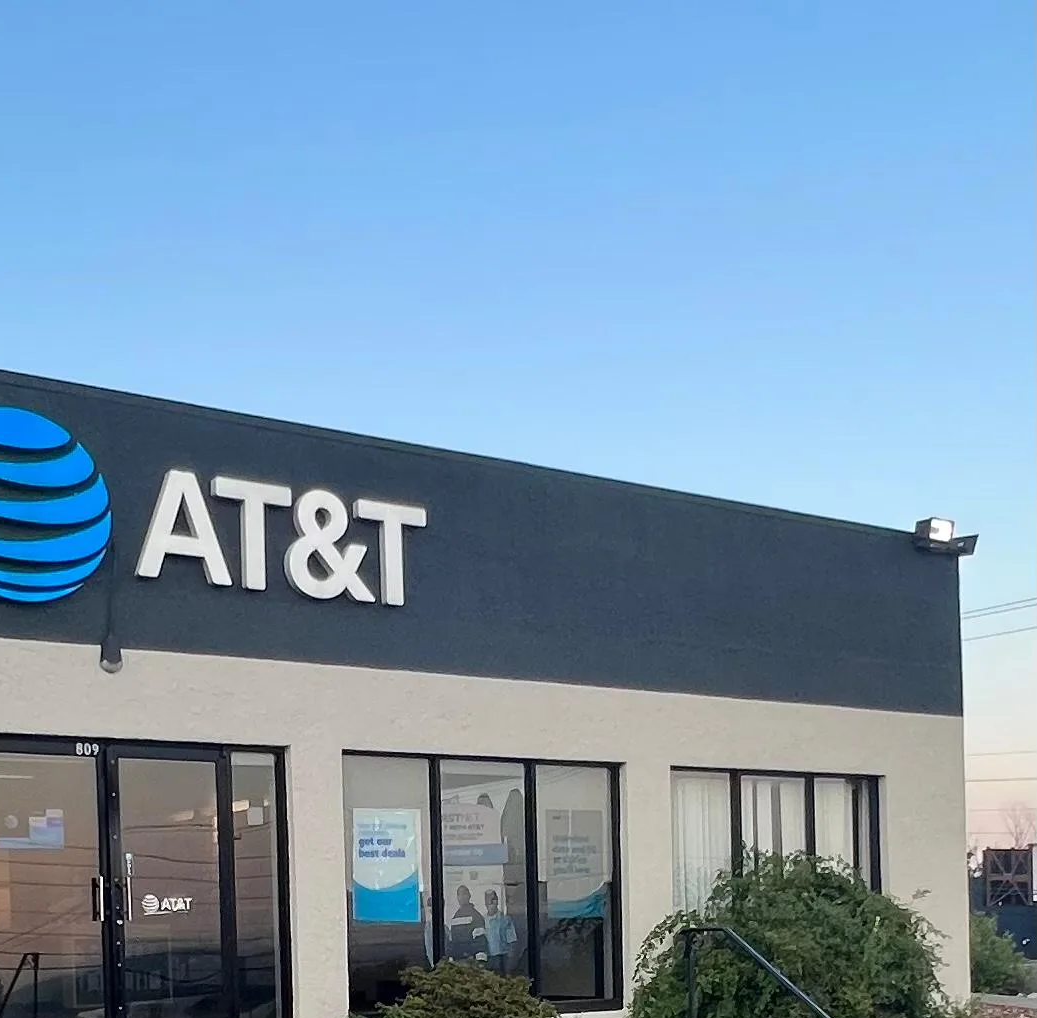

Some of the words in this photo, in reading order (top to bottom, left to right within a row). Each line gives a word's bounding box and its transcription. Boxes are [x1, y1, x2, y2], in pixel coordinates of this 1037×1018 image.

[134, 468, 427, 606] AT&T
[75, 742, 100, 756] 809
[160, 897, 193, 912] AT&T
